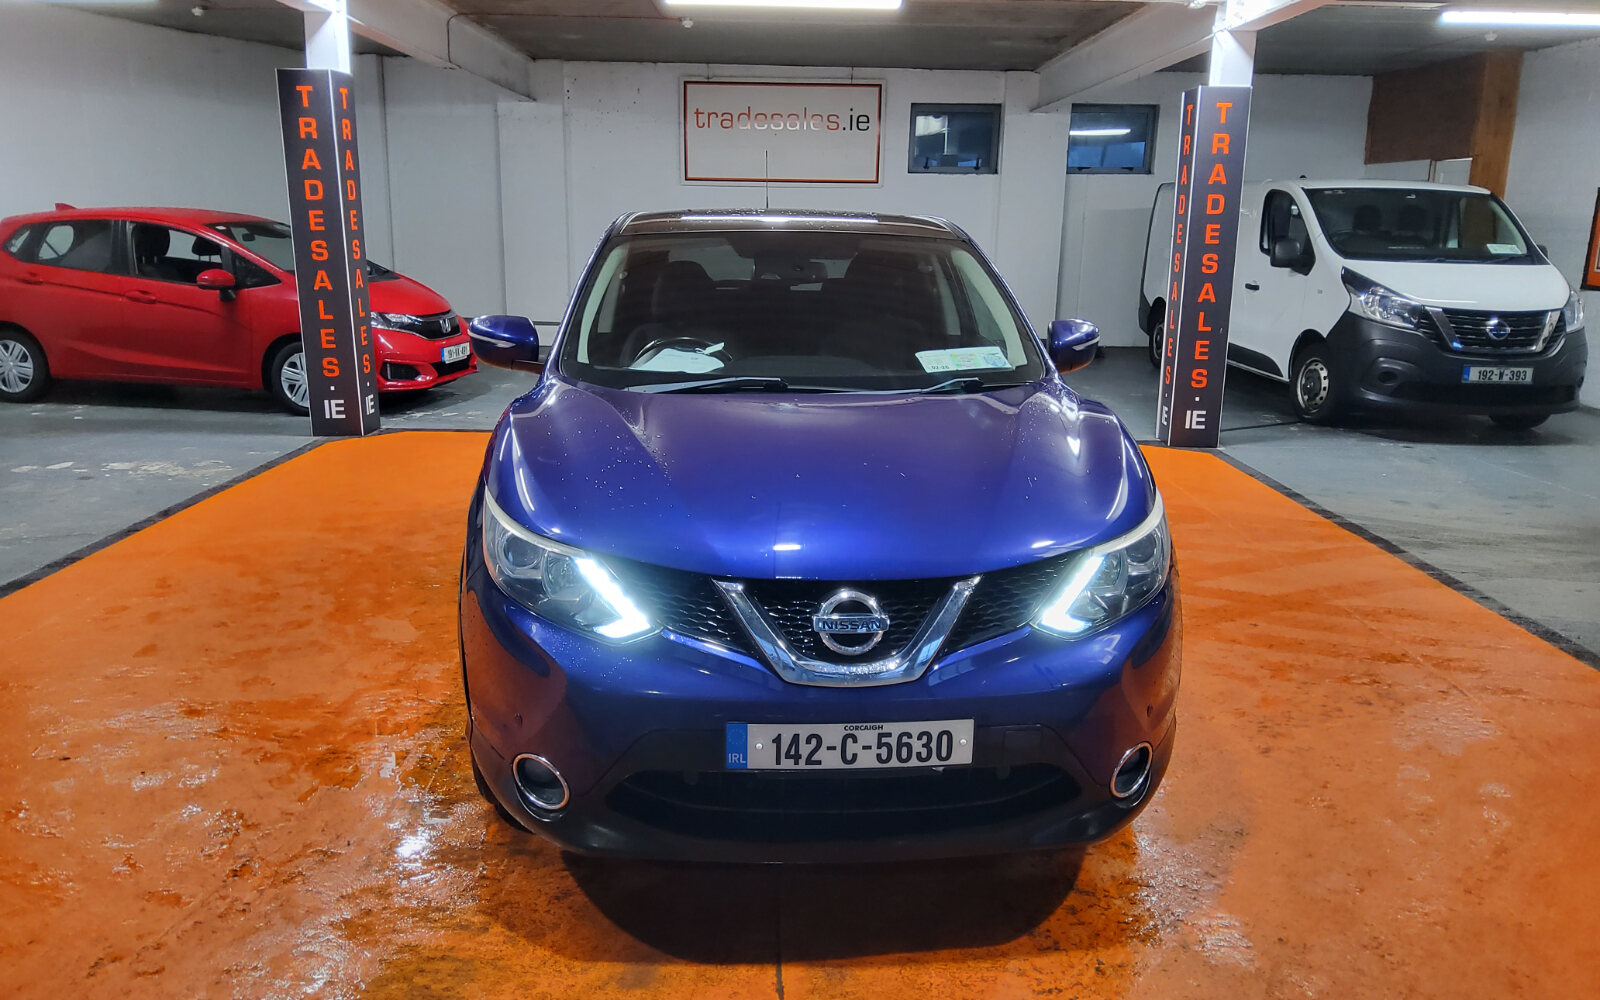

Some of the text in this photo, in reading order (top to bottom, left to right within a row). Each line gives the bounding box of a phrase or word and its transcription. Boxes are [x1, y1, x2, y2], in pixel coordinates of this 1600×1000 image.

[694, 106, 870, 132] tradesales.ie
[1478, 369, 1527, 381] 192-W-393
[822, 620, 881, 631] NISSAN
[843, 724, 884, 732] CORCAIGH
[771, 729, 954, 766] 142-C-5630
[728, 753, 746, 764] IRL
